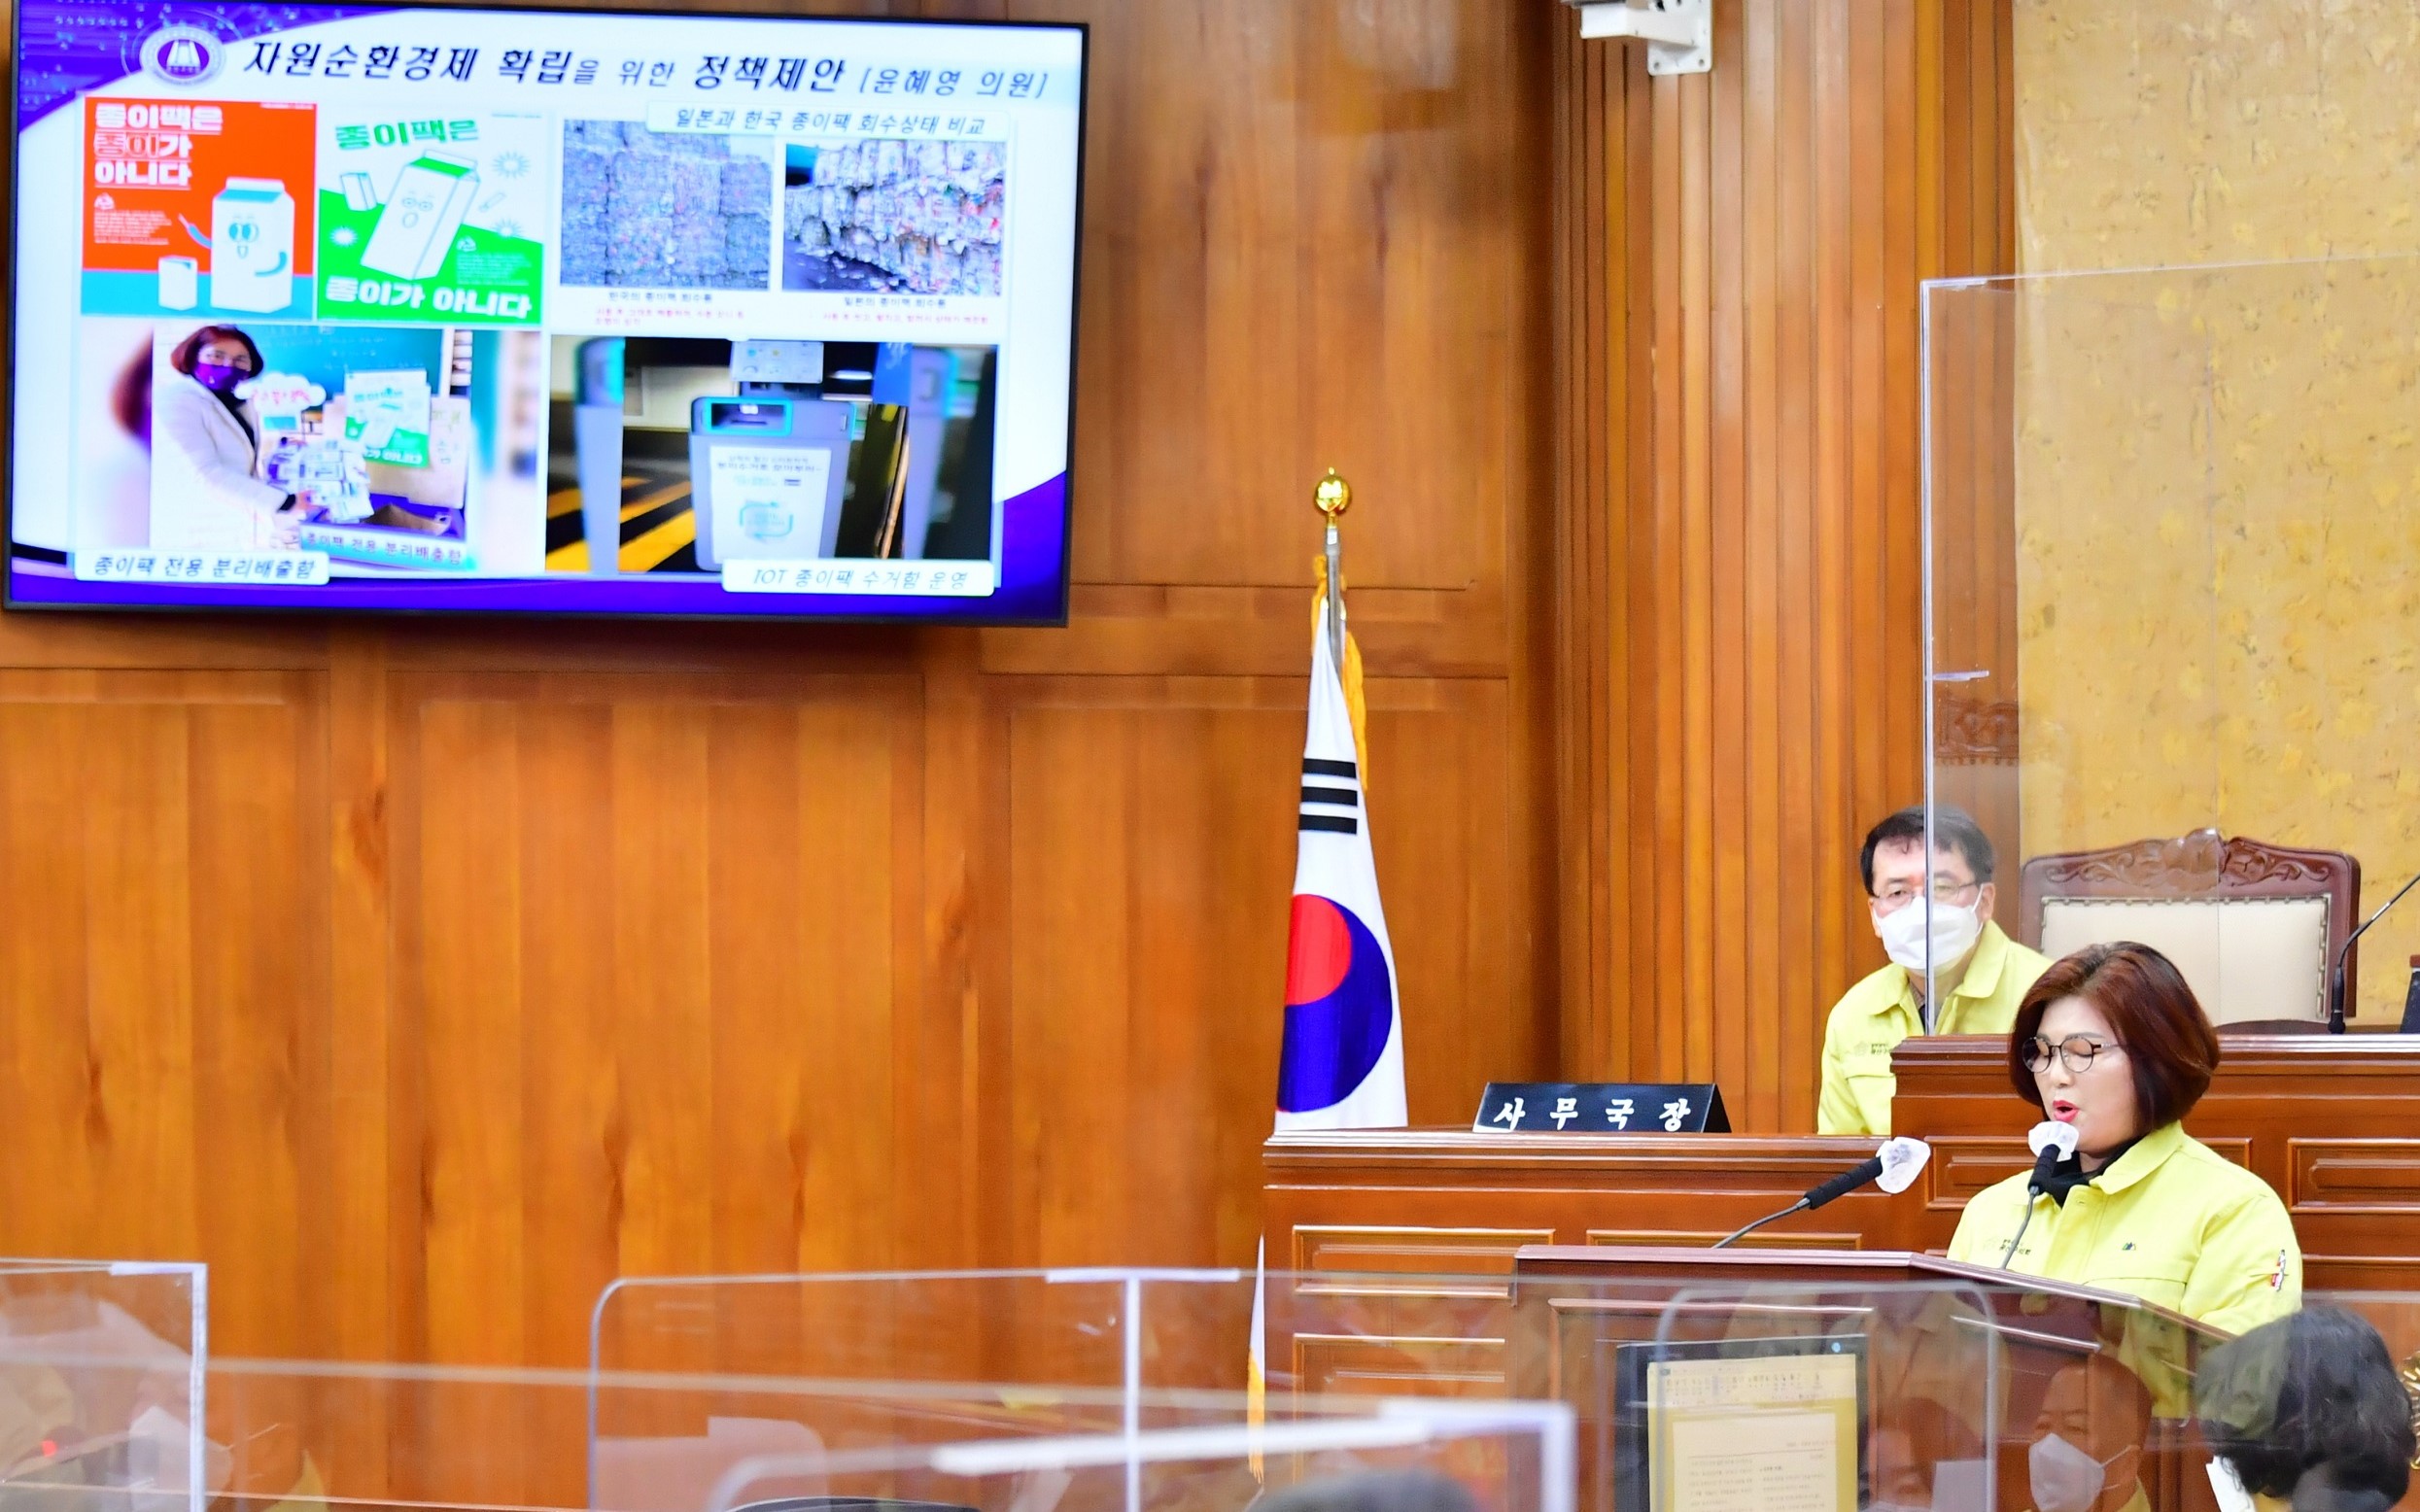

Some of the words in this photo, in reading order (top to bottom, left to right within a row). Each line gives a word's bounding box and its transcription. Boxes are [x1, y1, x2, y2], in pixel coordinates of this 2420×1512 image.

[243, 41, 478, 82] 자원순환경제
[499, 50, 600, 85] 확립을
[618, 59, 675, 87] 위한
[695, 55, 846, 92] 정책제안
[94, 103, 224, 131] 종이팩은
[676, 108, 736, 129] 일본과
[744, 110, 782, 130] 한국
[791, 111, 851, 132] 종이팩
[858, 112, 940, 134] 회수상태
[947, 116, 985, 135] 비교
[93, 132, 192, 157] 종이가
[335, 120, 479, 150] 종이팩은
[94, 160, 192, 186] 아니다
[326, 275, 426, 309] 종이가
[432, 286, 533, 320] 아니다
[94, 556, 156, 576] 종이팩
[165, 557, 202, 577] 전용
[213, 558, 316, 580] 분리배출함
[753, 569, 787, 584] IOT
[795, 569, 854, 589] 종이팩
[863, 570, 920, 590] 수거함
[929, 571, 969, 590] 운영
[1493, 1097, 1691, 1132] 사무국장
